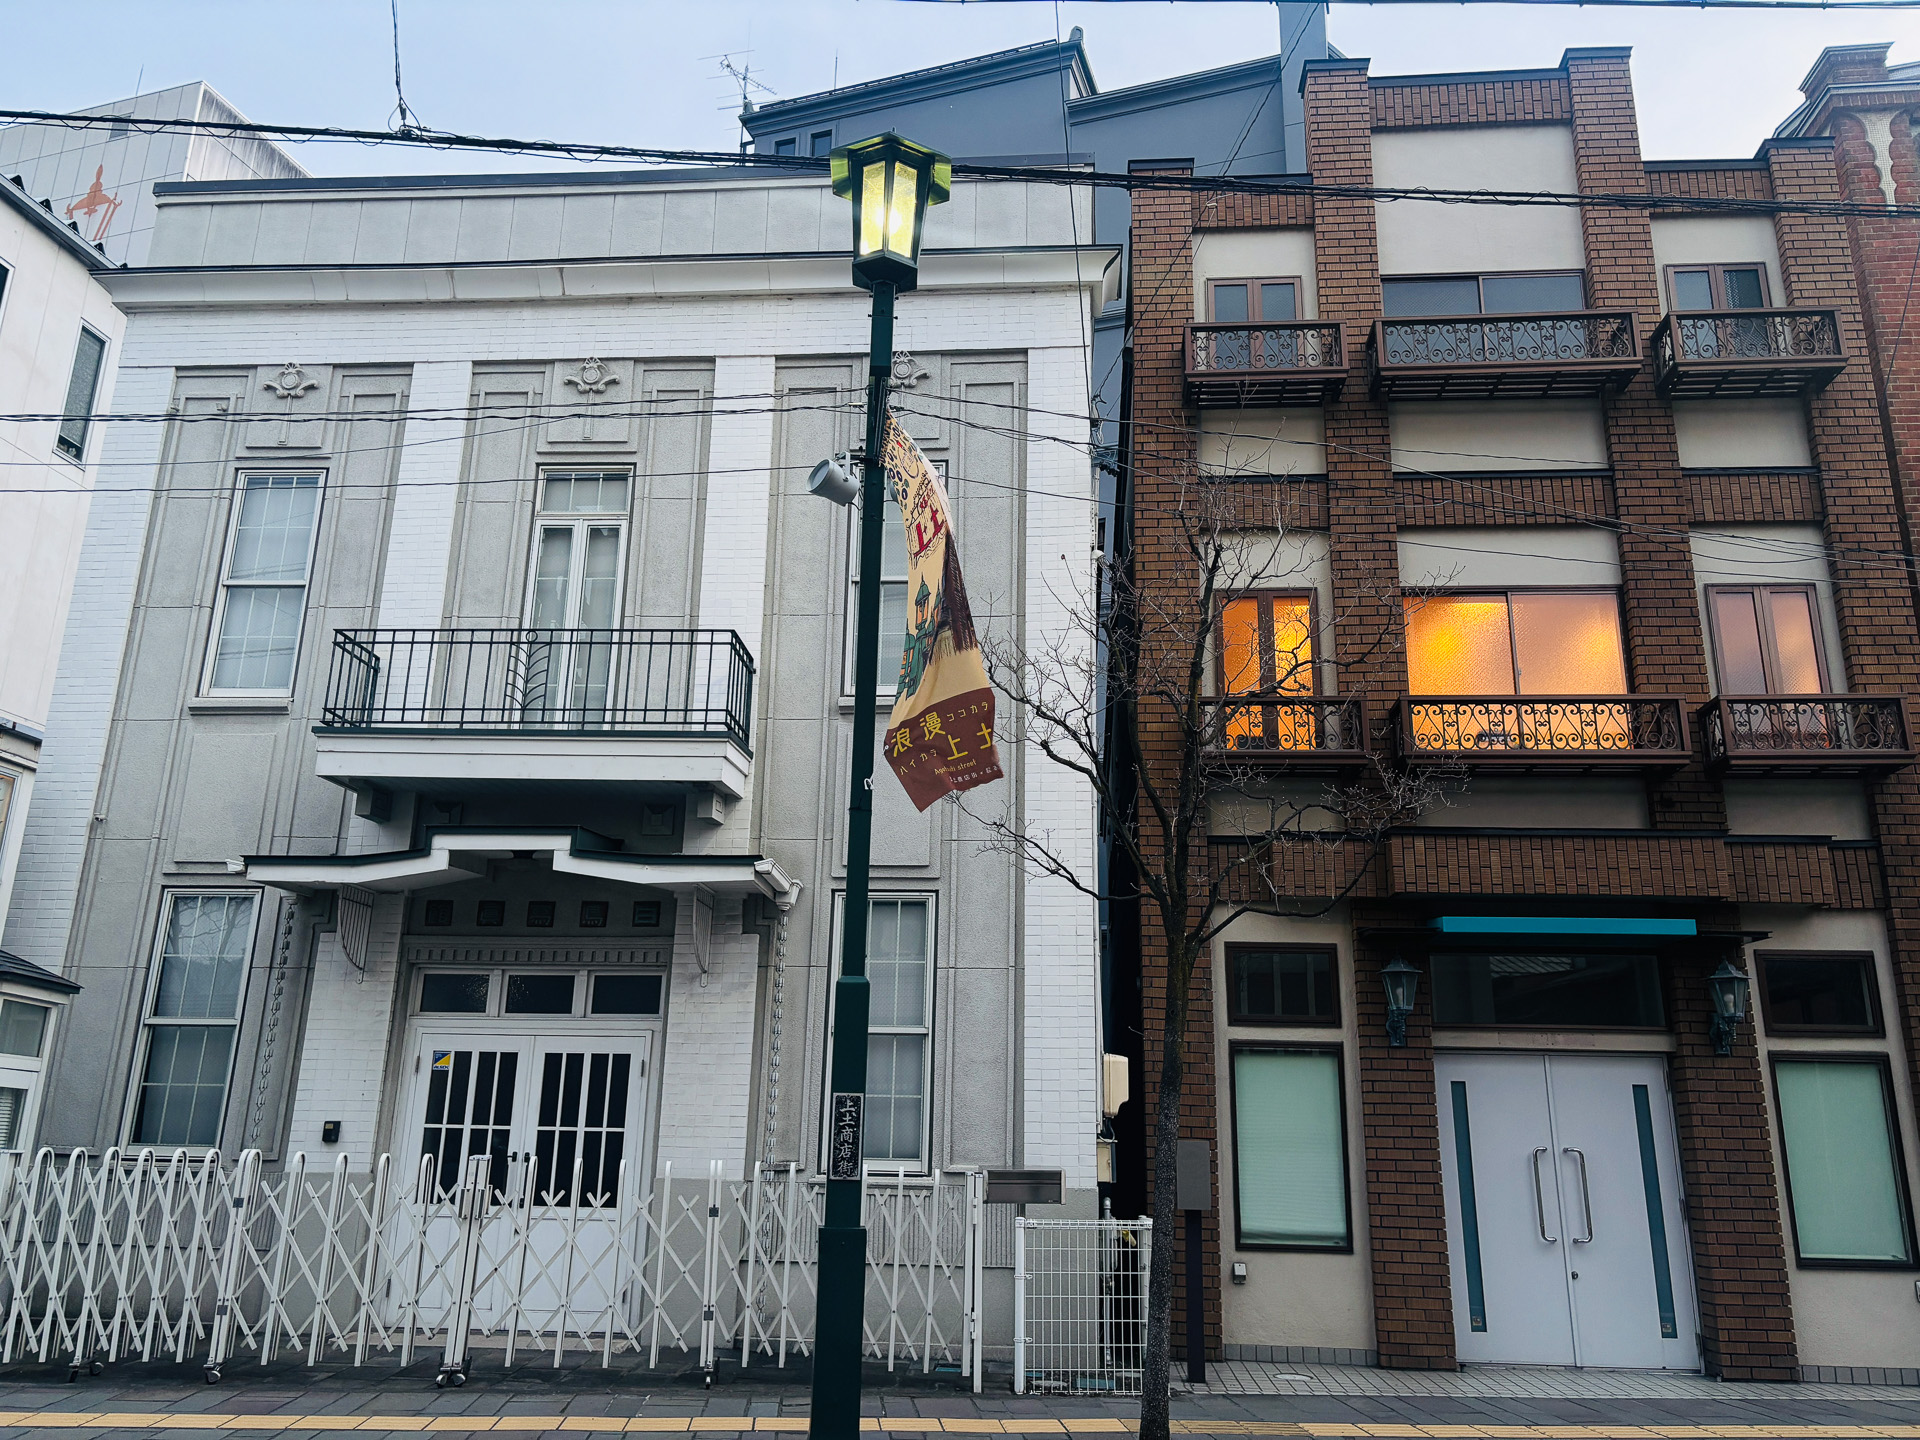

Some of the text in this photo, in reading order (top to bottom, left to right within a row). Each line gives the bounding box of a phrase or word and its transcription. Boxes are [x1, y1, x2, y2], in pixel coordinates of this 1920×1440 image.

[891, 701, 988, 757] 浪漫 ココカラ
[899, 748, 937, 775] ハイカラ
[957, 758, 977, 770] street
[837, 1099, 856, 1175] 上土商店街
